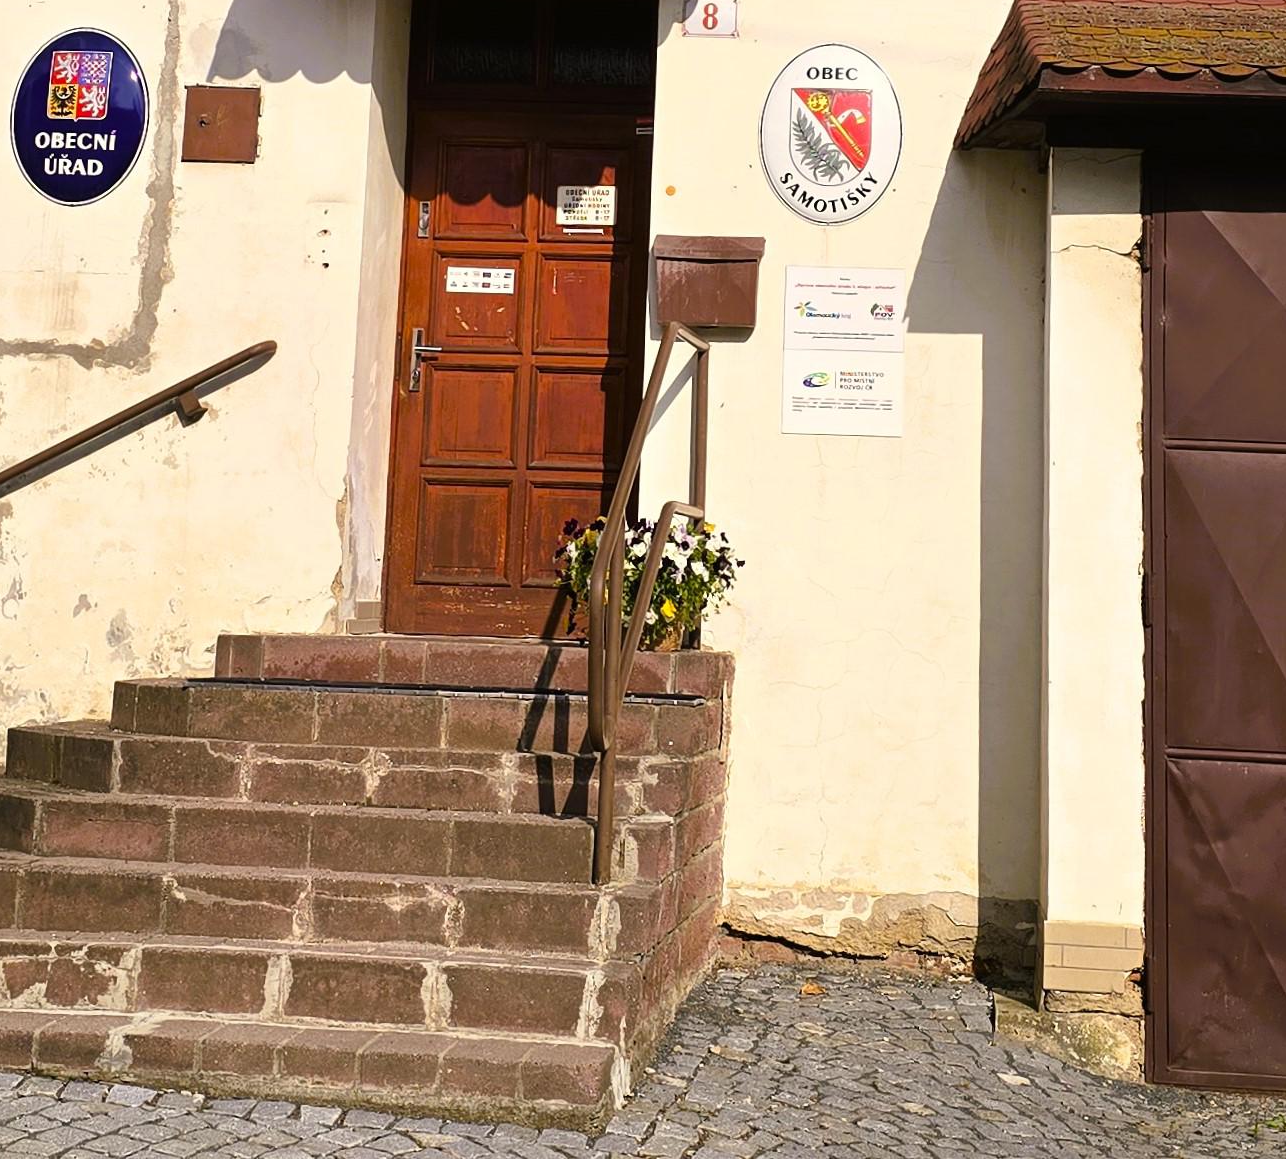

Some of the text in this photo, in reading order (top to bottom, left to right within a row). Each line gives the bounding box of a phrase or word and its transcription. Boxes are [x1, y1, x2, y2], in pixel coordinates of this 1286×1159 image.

[702, 2, 719, 30] 8
[806, 66, 858, 80] OBEC
[34, 130, 116, 151] OBECNÍ
[44, 153, 103, 176] ÚŘAD
[779, 171, 878, 213] SAMOTIŠKY
